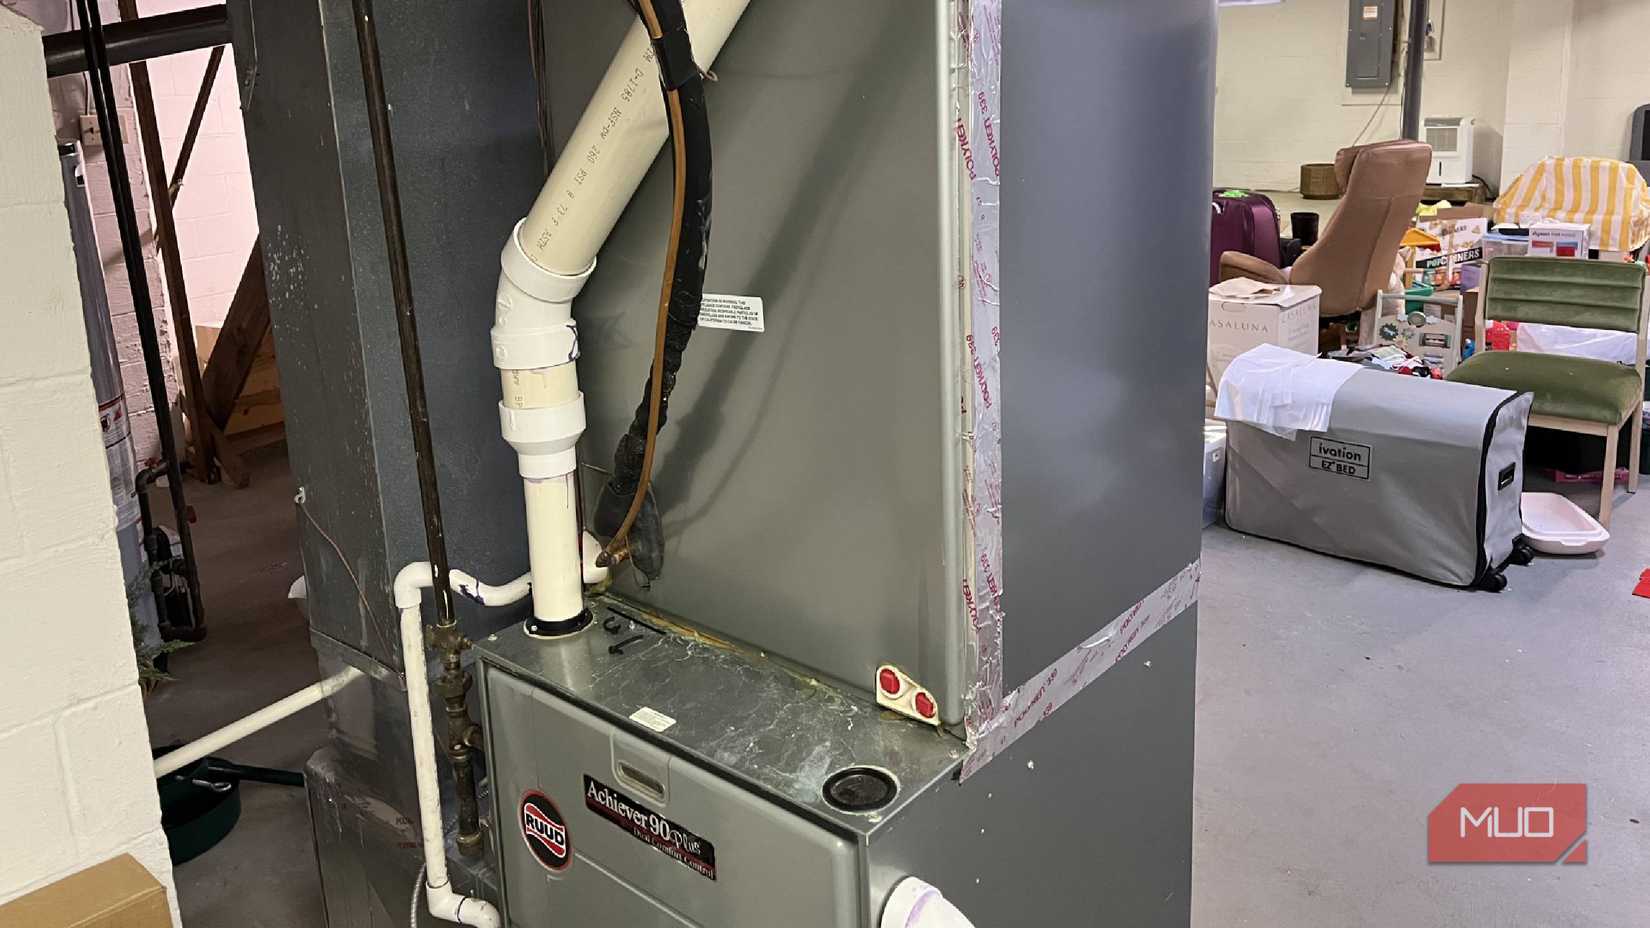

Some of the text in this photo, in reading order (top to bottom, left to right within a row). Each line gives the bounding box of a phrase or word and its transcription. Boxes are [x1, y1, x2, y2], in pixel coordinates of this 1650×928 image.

[983, 116, 1000, 177] POLYKEN
[1209, 319, 1269, 333] ASALUNA
[1318, 442, 1362, 462] ivation
[1336, 463, 1356, 475] BED
[525, 812, 565, 847] RUUD
[587, 781, 701, 855] Achiever 90 Plus
